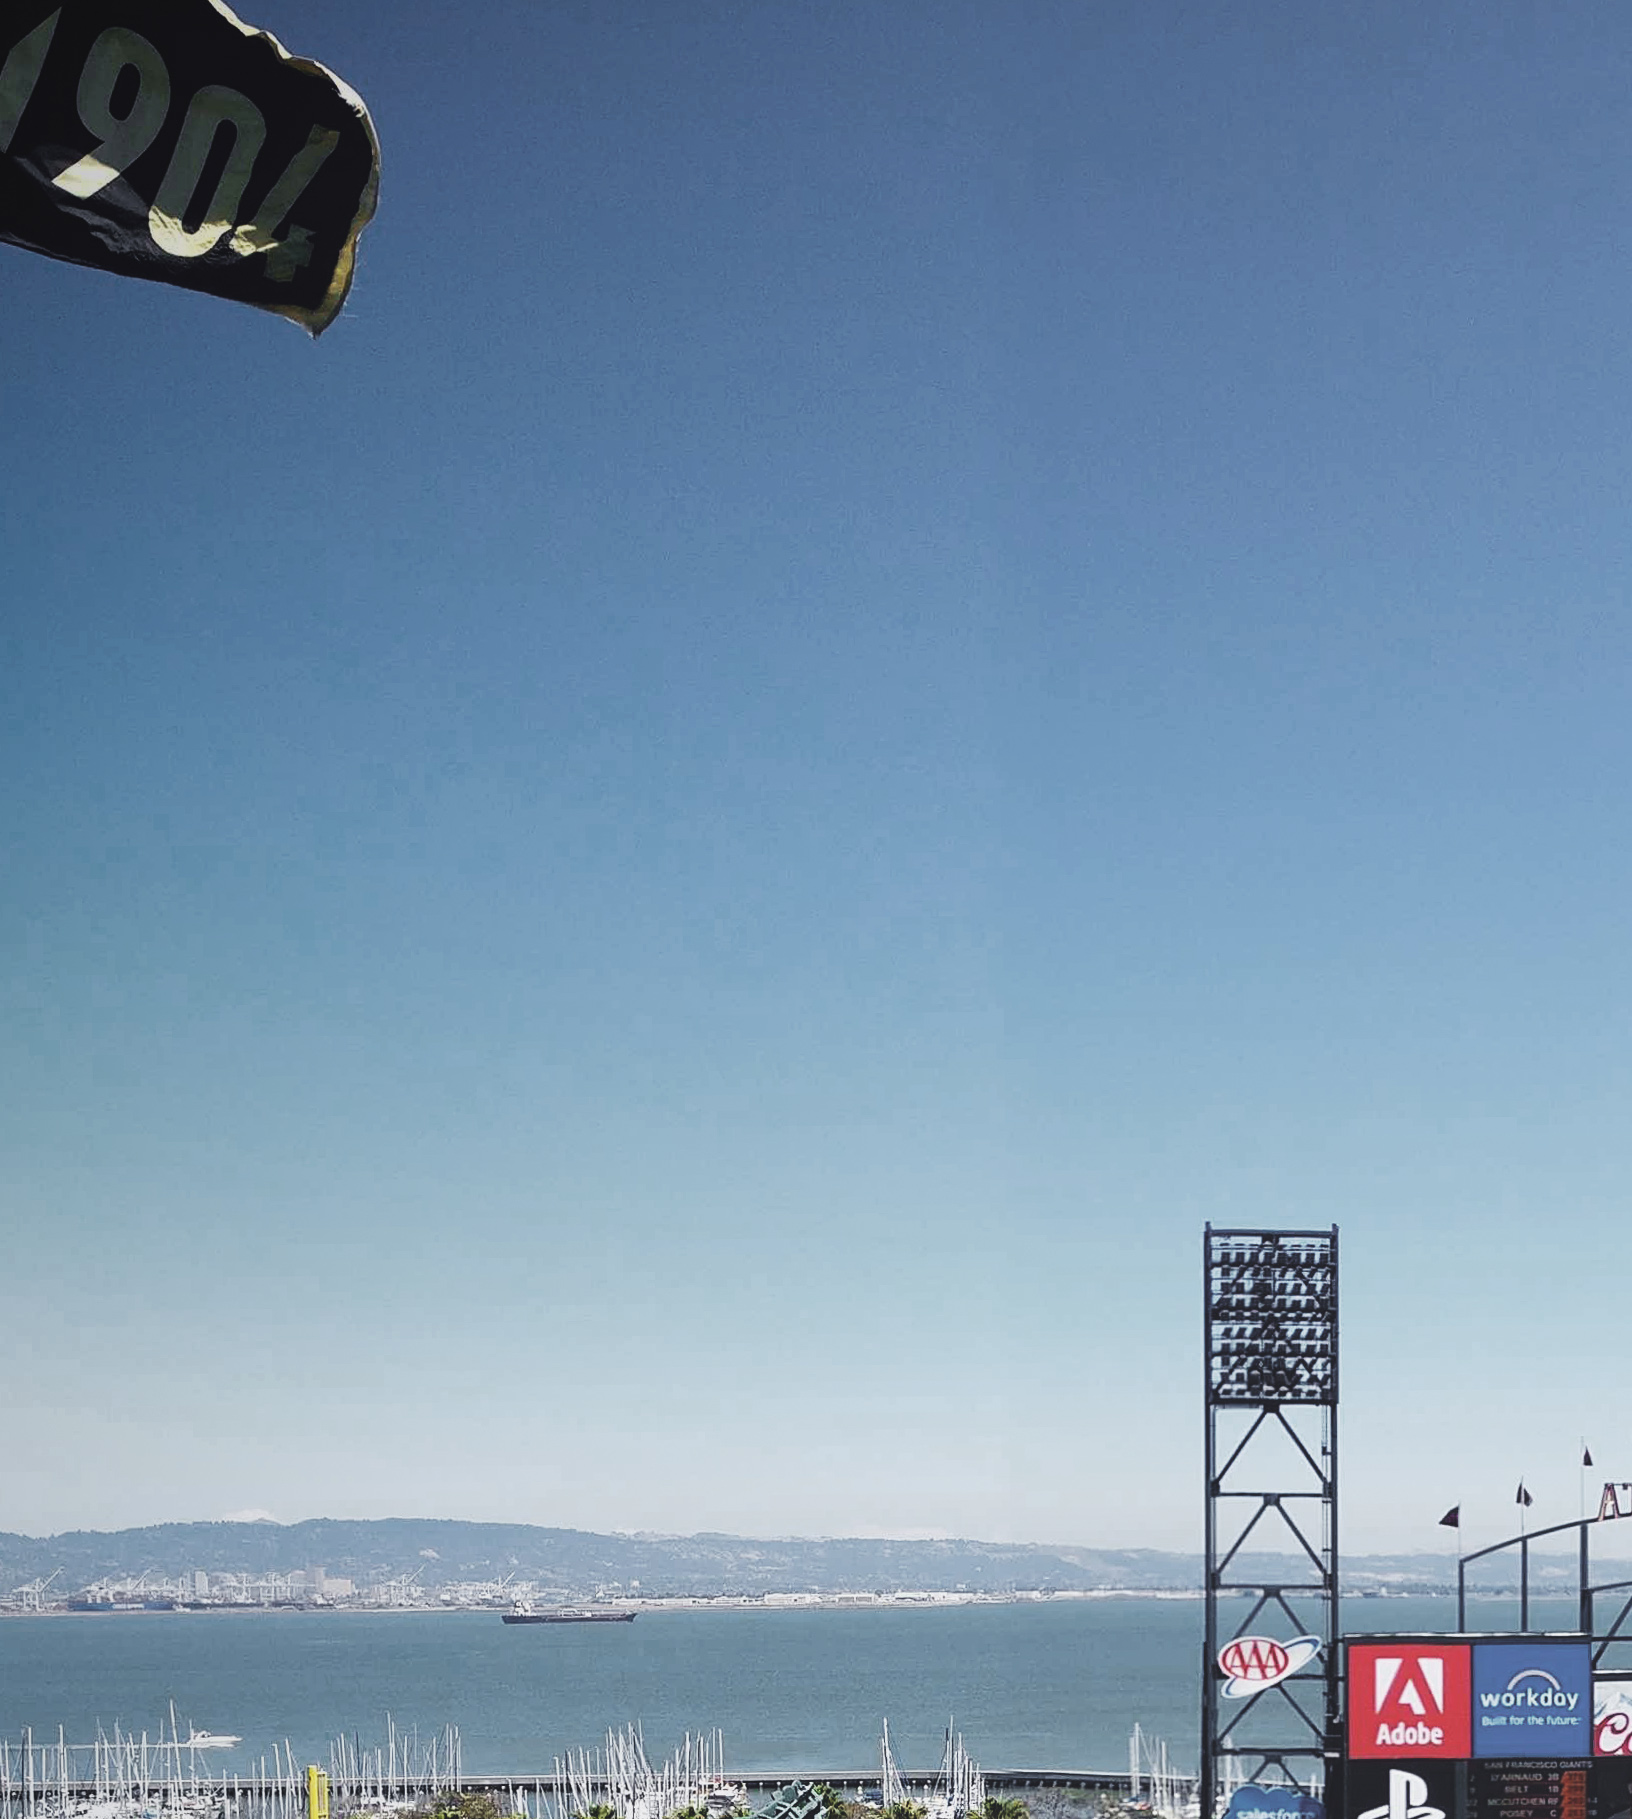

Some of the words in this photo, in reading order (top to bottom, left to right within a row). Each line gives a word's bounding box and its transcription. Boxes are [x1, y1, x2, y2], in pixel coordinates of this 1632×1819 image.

[1229, 1641, 1283, 1679] AAA
[1480, 1688, 1579, 1712] workday
[1481, 1715, 1508, 1727] Built
[1509, 1714, 1525, 1727] for
[1527, 1714, 1544, 1727] the
[1376, 1722, 1444, 1745] Adobe
